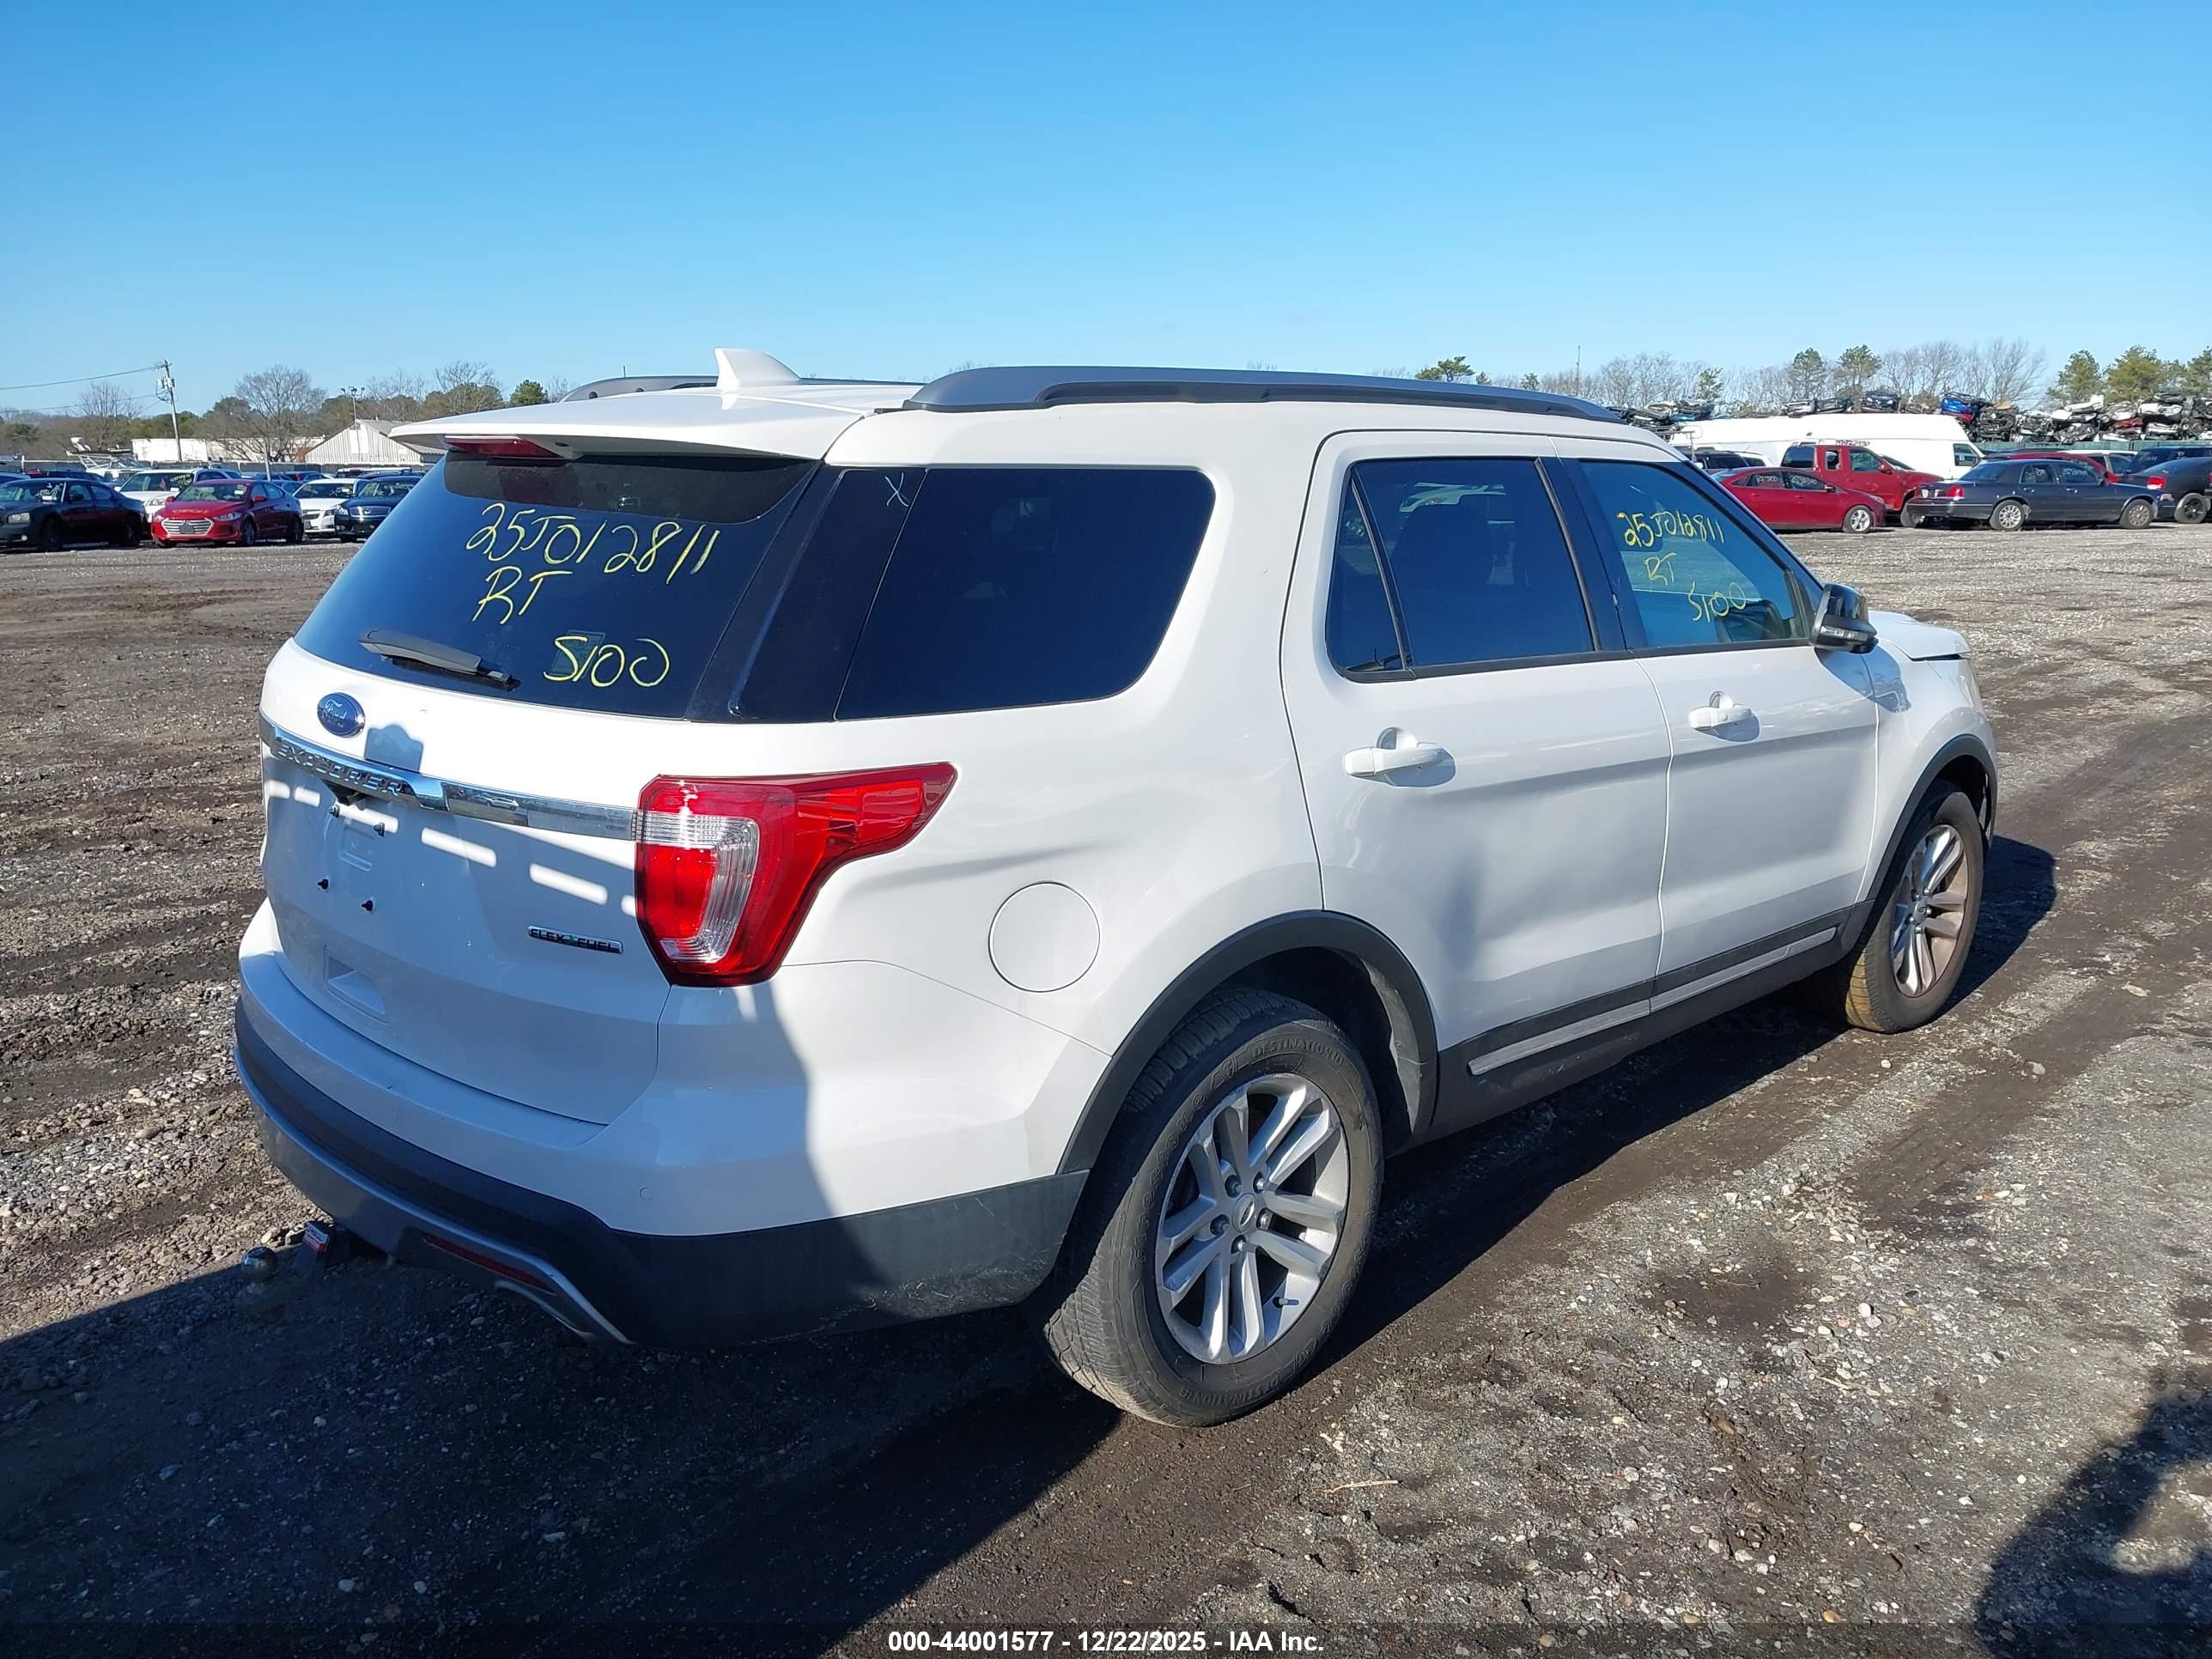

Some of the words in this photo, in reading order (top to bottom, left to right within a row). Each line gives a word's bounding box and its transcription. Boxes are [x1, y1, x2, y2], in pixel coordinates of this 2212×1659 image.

[1644, 552, 1677, 586] RT
[471, 566, 573, 624] RT
[277, 743, 402, 797] EXPLORER
[531, 928, 565, 945] FLEX
[577, 938, 621, 954] FUEL
